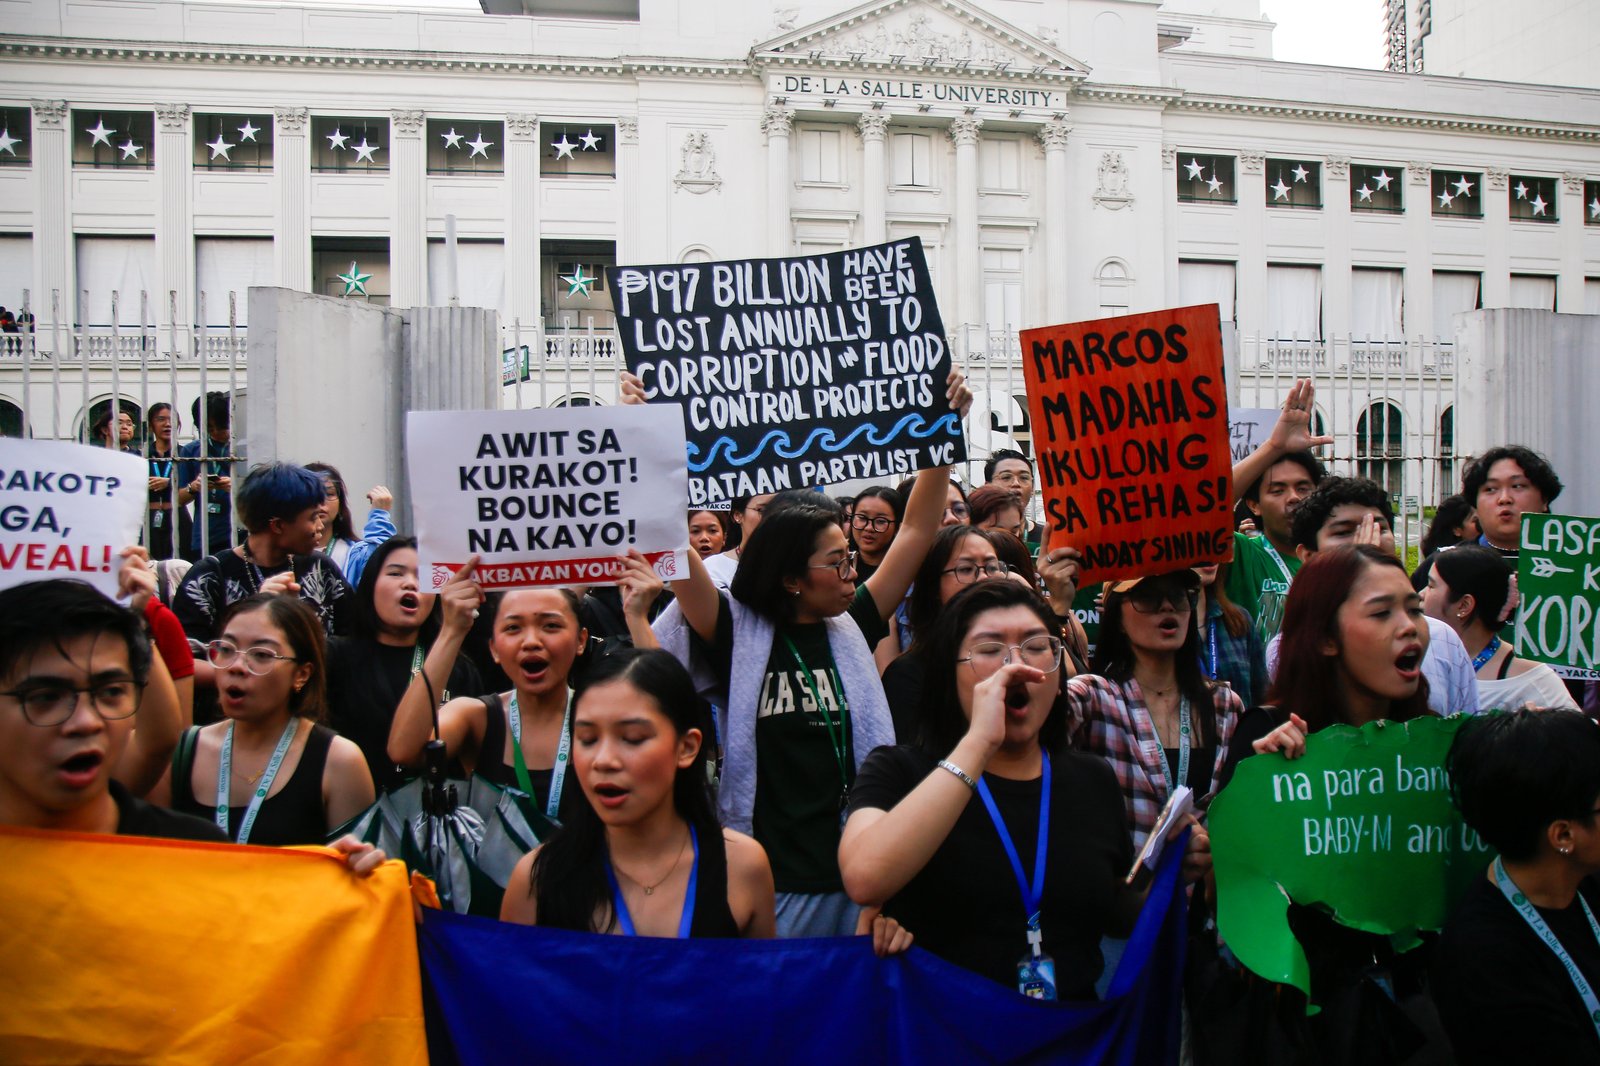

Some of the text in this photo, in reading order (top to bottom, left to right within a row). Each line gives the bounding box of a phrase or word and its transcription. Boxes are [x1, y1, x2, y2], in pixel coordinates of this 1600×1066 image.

[785, 76, 1052, 107] DE LA SALLE UNIVERSITY
[712, 258, 832, 307] BILLION
[843, 243, 911, 276] HAVE
[844, 270, 916, 301] BEEN
[635, 296, 922, 353] LOST ANNUALLY TO
[635, 332, 944, 401] CORRUPTION IN FLOOD
[1032, 323, 1189, 383] MARCOS
[689, 373, 934, 432] CONTROL PROJECTS
[1041, 375, 1218, 442] MADAHAS
[476, 428, 622, 459] AWIT SA
[1229, 421, 1259, 443] IT
[459, 457, 638, 491] KURAKOT!
[688, 441, 955, 506] BATAAN PARTYLIST VC
[1041, 434, 1210, 487] IKULONG
[1, 505, 71, 537] GA,
[477, 490, 621, 522] BOUNCE
[1047, 476, 1228, 533] SA REHAS!
[0, 543, 112, 573] VEAL!
[468, 519, 637, 553] NA KAYO!
[471, 564, 571, 585] AKBAYAN
[1071, 609, 1100, 624] ON
[1514, 592, 1600, 669] KOR
[758, 671, 795, 719] LA
[1566, 669, 1587, 677] YAK
[1590, 670, 1600, 678] C
[1272, 754, 1452, 811] na para ban
[1522, 904, 1535, 919] De
[1533, 917, 1544, 931] La
[1543, 929, 1559, 950] Salle
[1558, 950, 1590, 996] University
